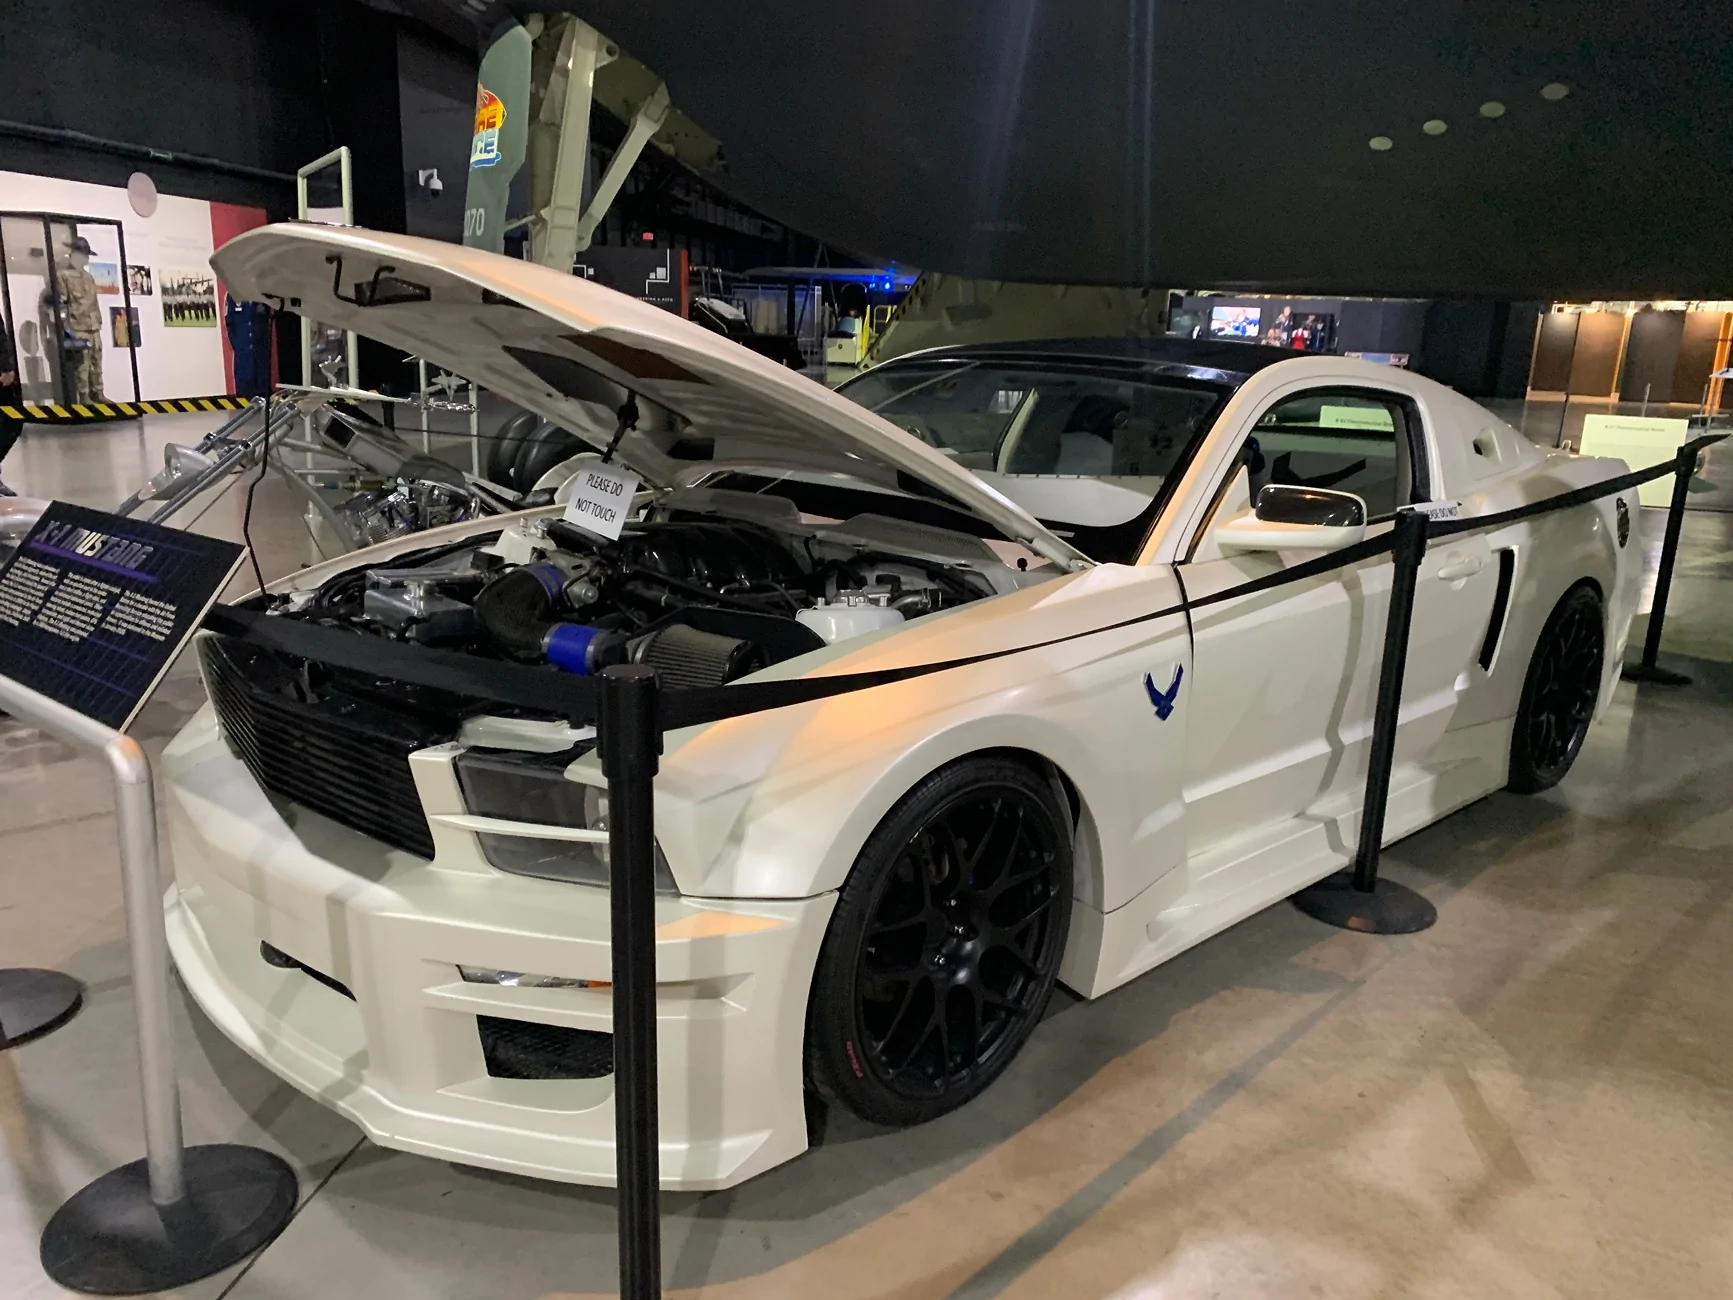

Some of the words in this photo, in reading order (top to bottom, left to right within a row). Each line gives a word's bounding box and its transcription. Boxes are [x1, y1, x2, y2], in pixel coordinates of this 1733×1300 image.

[586, 473, 611, 493] PLEASE
[610, 482, 623, 496] DO
[575, 498, 592, 513] NOT
[591, 503, 616, 523] TOUCH
